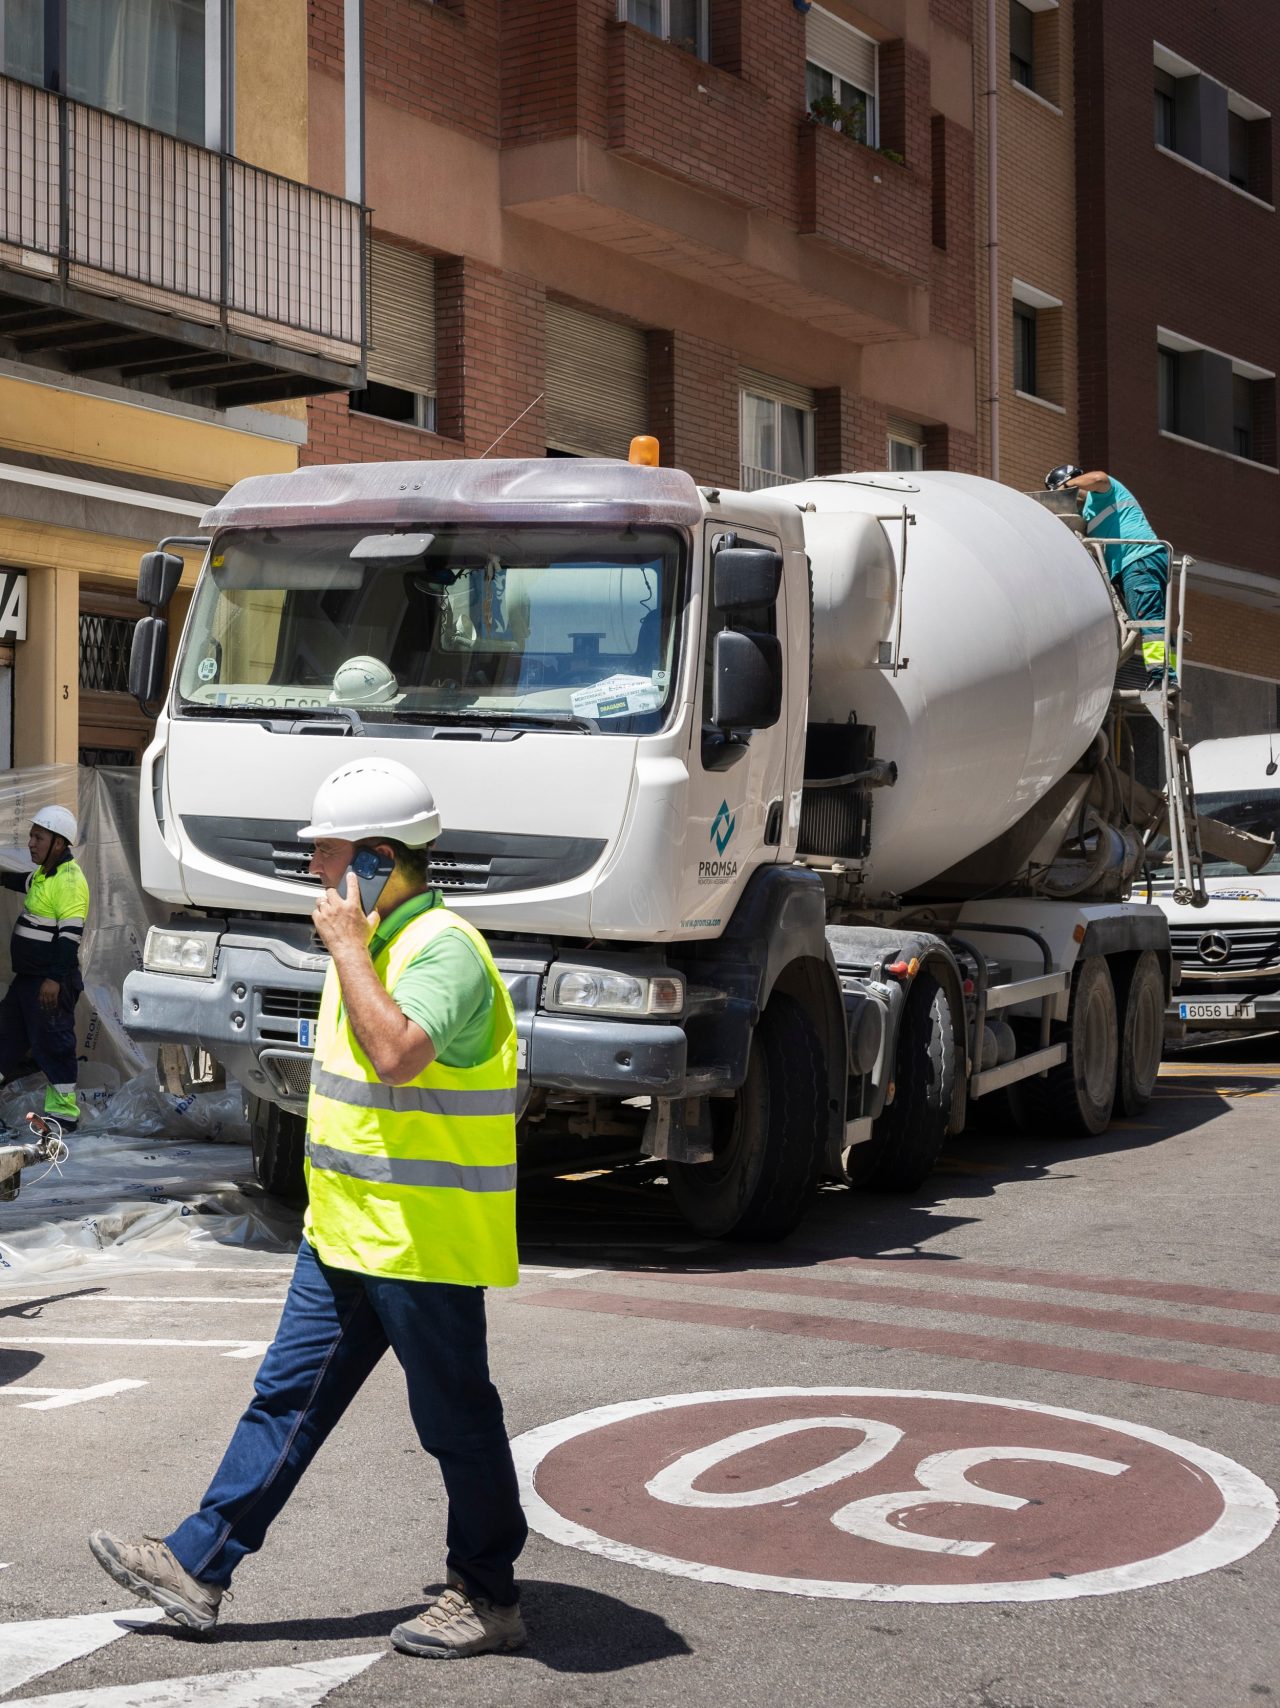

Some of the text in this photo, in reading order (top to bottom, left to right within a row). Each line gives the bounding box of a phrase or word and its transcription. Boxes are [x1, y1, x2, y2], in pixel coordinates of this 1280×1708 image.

[62, 685, 70, 700] 3
[698, 861, 738, 877] PROMSA
[1189, 1005, 1251, 1018] 6056 LHT
[645, 1416, 1129, 1557] 30
